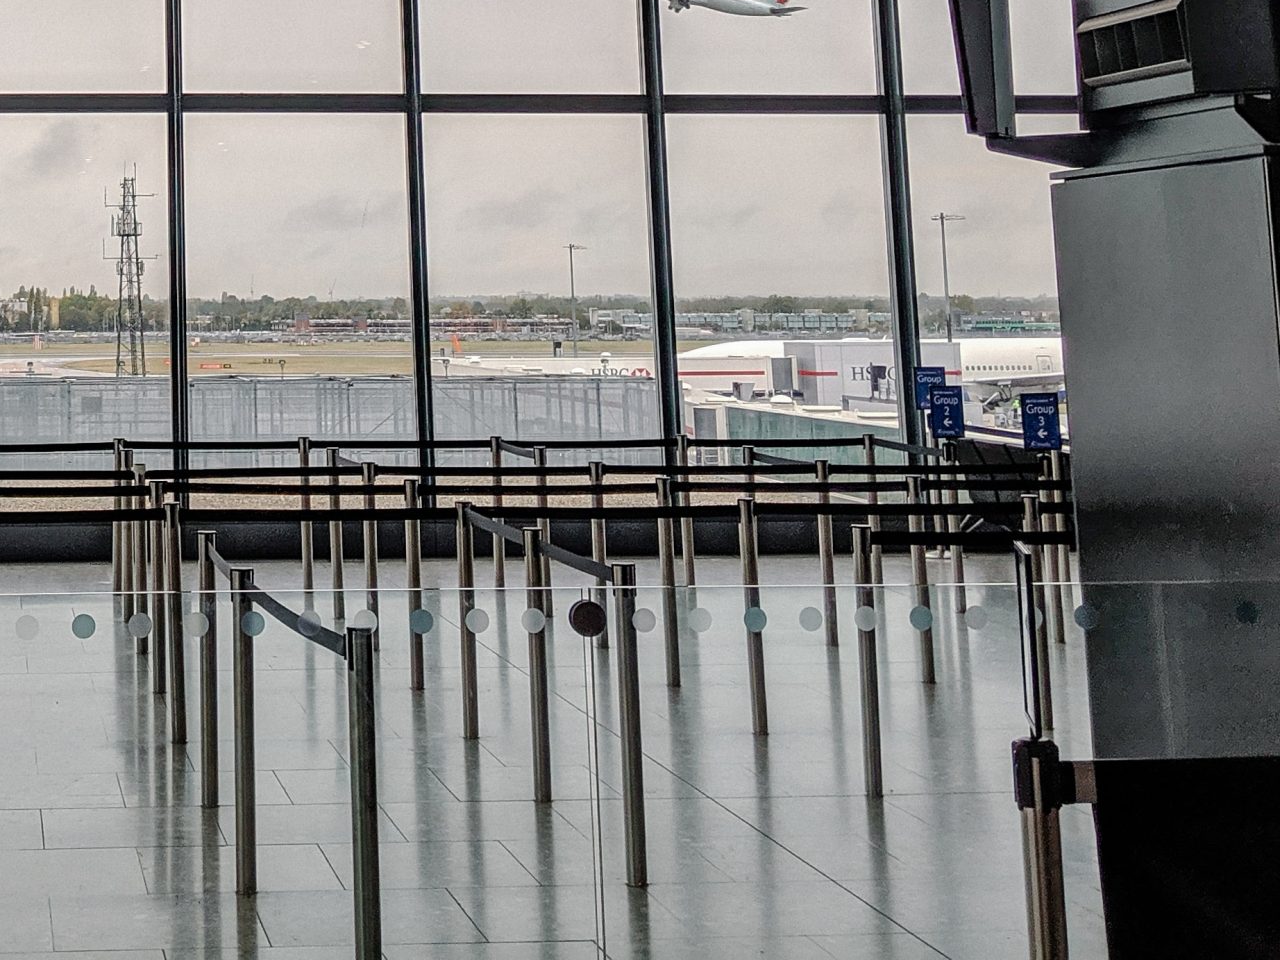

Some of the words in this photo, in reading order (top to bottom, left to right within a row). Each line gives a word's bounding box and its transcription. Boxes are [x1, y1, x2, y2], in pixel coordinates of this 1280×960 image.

[917, 375, 942, 384] Group
[933, 395, 959, 406] Group
[943, 406, 950, 416] 2
[1026, 404, 1055, 415] Group
[1038, 416, 1045, 427] 3
